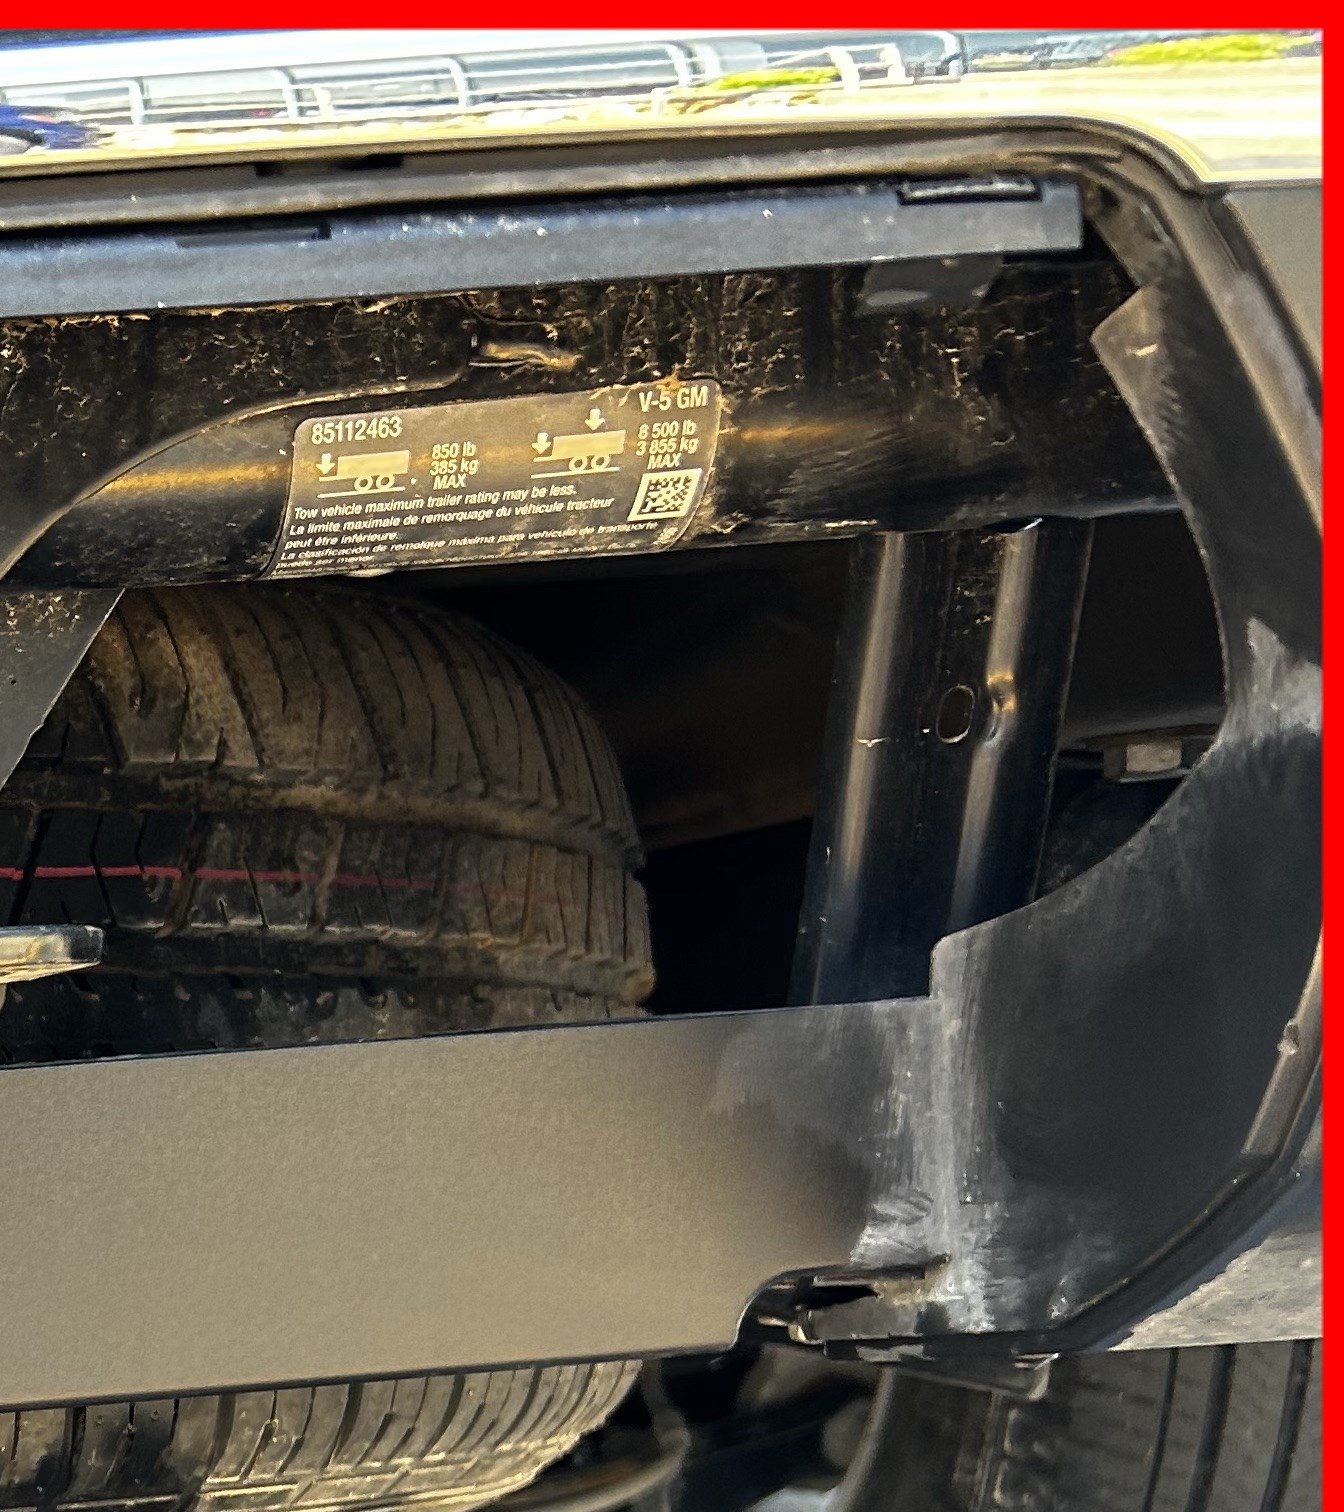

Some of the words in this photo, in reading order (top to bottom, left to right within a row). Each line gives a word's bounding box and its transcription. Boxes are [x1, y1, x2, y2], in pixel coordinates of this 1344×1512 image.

[639, 390, 672, 412] V-5
[676, 385, 708, 409] GM
[312, 415, 403, 445] 85112463
[652, 420, 680, 439] 500
[682, 419, 697, 436] lb
[431, 442, 459, 460] 850
[462, 441, 477, 457] lb
[635, 440, 647, 456] 3
[649, 437, 677, 455] 855
[679, 437, 699, 454] kg
[429, 459, 457, 476] 385
[461, 458, 480, 476] kg
[647, 453, 682, 470] MAX
[433, 474, 466, 491] MAX
[294, 507, 318, 520] Tow
[321, 503, 362, 518] vehicle
[364, 497, 424, 514] maximum
[427, 494, 462, 509] trailer
[464, 490, 501, 505] rating
[502, 488, 530, 503] may
[531, 486, 548, 499] be
[549, 484, 577, 497] less.
[289, 524, 305, 536] La
[307, 520, 340, 534] limite
[343, 516, 401, 531] maximale
[403, 514, 419, 525] de
[421, 508, 493, 524] remorquage
[496, 506, 512, 518] du
[514, 502, 564, 516] véhicule
[567, 498, 615, 511] tracteur
[284, 538, 312, 551] peut
